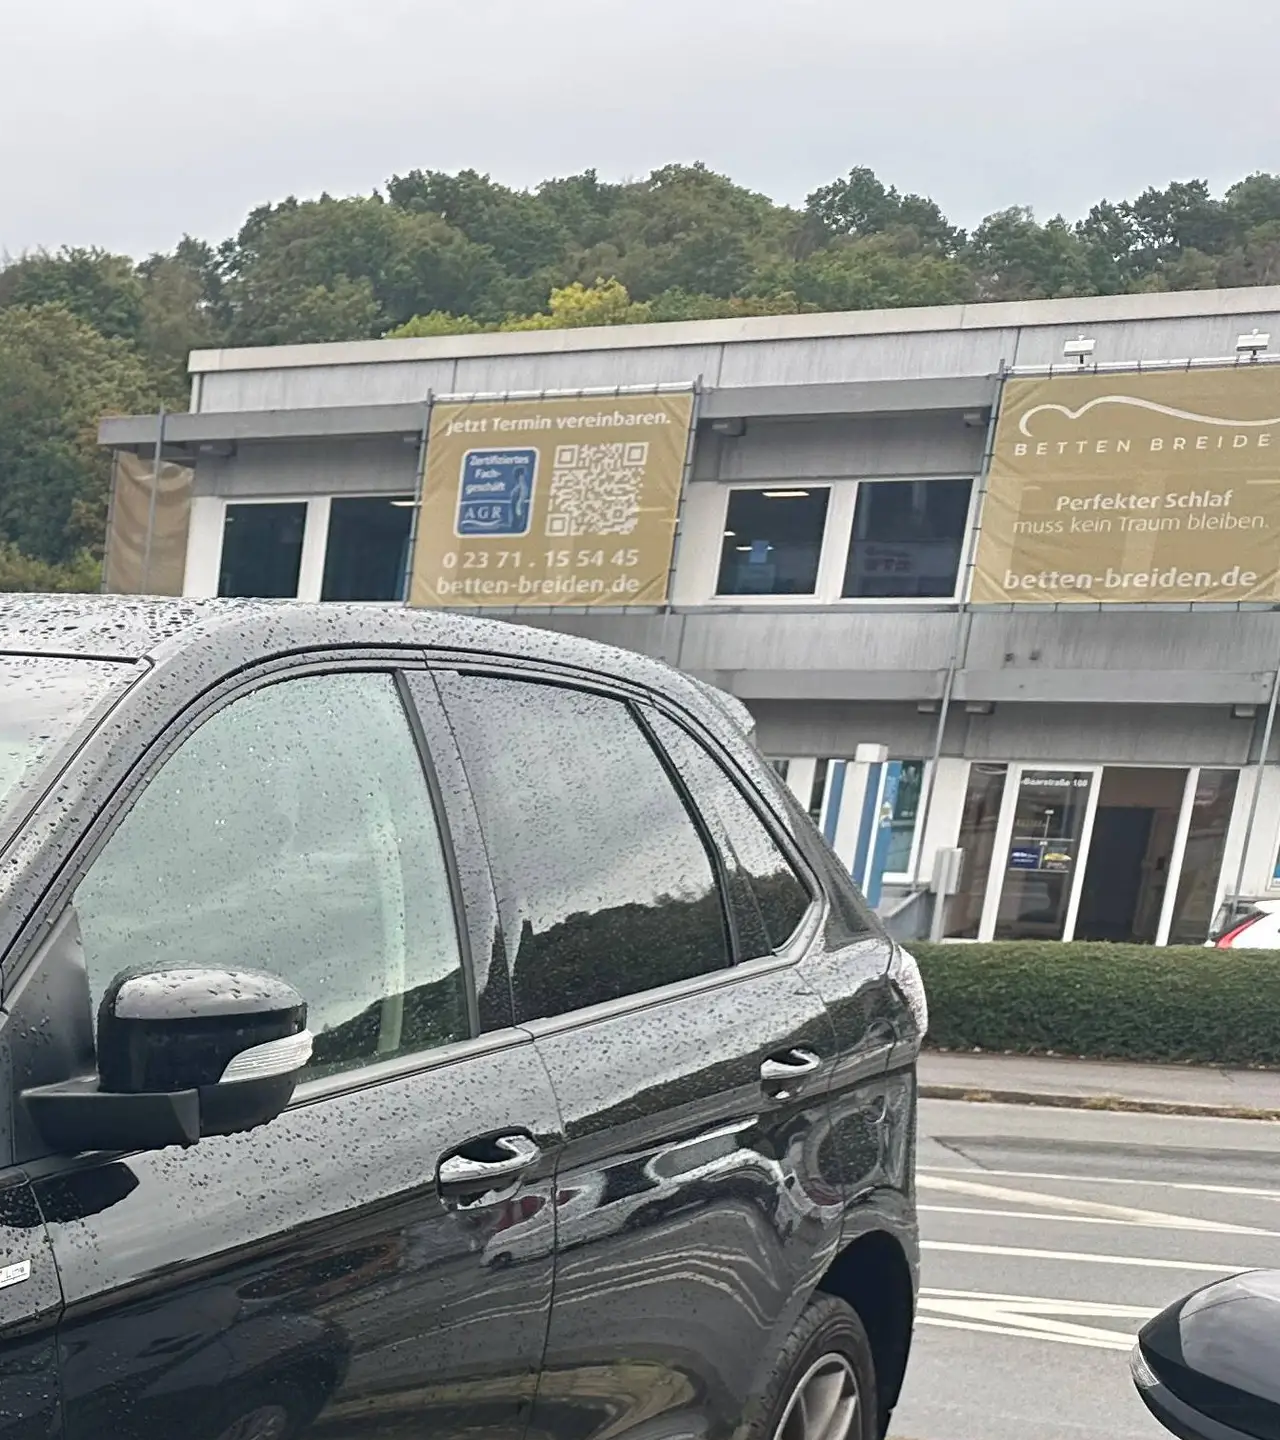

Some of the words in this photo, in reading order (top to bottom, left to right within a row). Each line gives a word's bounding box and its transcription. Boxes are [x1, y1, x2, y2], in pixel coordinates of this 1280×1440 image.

[493, 415, 552, 432] Termin
[556, 411, 671, 429] vereinbaren.
[1014, 439, 1131, 456] BETTEN
[1150, 434, 1272, 451] BREIDE
[1056, 494, 1160, 511] Perfekter
[1164, 489, 1233, 509] Schlaf
[1013, 519, 1064, 534] muss
[1070, 516, 1112, 533] kein
[1119, 516, 1180, 532] Traum
[1188, 512, 1269, 530] bleiben.
[463, 551, 490, 569] 23
[496, 551, 522, 569] 71
[544, 550, 571, 568] 15
[576, 550, 604, 567] 54
[611, 549, 639, 567] 45
[436, 575, 640, 595] betten-breiden.de
[1003, 566, 1258, 590] betten-breiden.de
